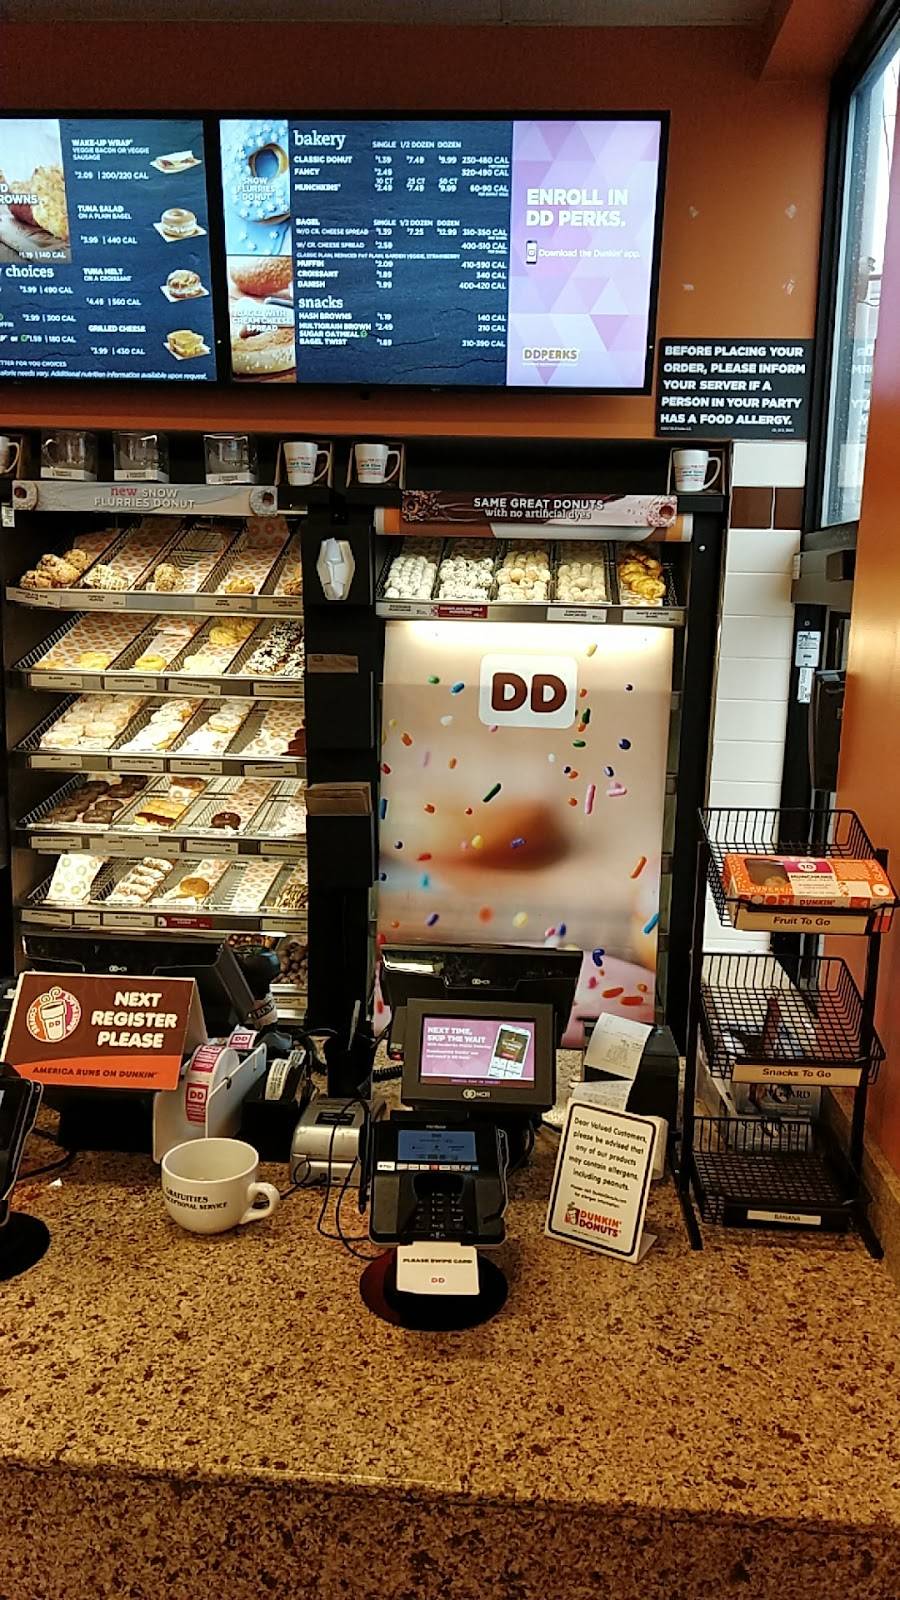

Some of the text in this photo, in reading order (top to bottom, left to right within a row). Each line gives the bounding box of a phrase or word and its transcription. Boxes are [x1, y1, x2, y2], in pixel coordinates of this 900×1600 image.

[293, 130, 346, 150] bakery
[293, 156, 353, 164] CLASSIC DONUT
[133, 172, 149, 180] CAL
[294, 168, 320, 176] FANCY
[494, 185, 509, 193] CAL
[526, 188, 628, 206] ENROLL IN
[296, 218, 321, 226] BAGEL
[526, 210, 626, 227] DD PERKS.
[492, 242, 508, 250] CAL
[5, 265, 54, 278] choices
[491, 282, 507, 290] CAL
[298, 294, 344, 309] snacks
[298, 312, 352, 320] HASH BROWNS
[664, 345, 804, 357] BEFORE PLACING YOUR
[663, 363, 806, 375] ORDER, PLEASE INFORM
[663, 380, 772, 391] YOUR SERVER IF A
[661, 396, 802, 409] PERSON IN YOUR PARTY
[660, 413, 793, 426] HAS A FOOD ALLERGY.
[111, 487, 178, 498] new SNOW
[94, 498, 195, 509] FLURRIES DONUT
[473, 497, 604, 511] SAME GREAT DONUTS
[484, 509, 506, 518] with
[525, 508, 566, 519] artificial
[568, 511, 591, 521] dyes
[491, 672, 567, 713] DD
[773, 916, 831, 927] Fruit To Go
[113, 991, 162, 1008] NEXT
[91, 1010, 178, 1029] REGISTER
[427, 1026, 473, 1036] NEXT TIME,
[97, 1031, 164, 1048] PLEASE
[427, 1034, 486, 1044] SKIP THE WAIT
[33, 1066, 74, 1076] AMERICA
[76, 1069, 101, 1077] RUNS
[762, 1068, 832, 1079] Snacks To Go
[190, 1090, 204, 1100] DD
[574, 1117, 648, 1144] Dear Valued Customers,
[573, 1131, 594, 1142] please
[604, 1139, 630, 1151] advised
[630, 1144, 645, 1155] that
[575, 1144, 588, 1154] any
[597, 1150, 608, 1158] our
[608, 1154, 637, 1167] products
[568, 1155, 582, 1166] may
[583, 1159, 607, 1171] contain
[573, 1167, 630, 1191] including peanuts.
[774, 1214, 801, 1222] BANANA
[579, 1219, 619, 1238] DONUTS
